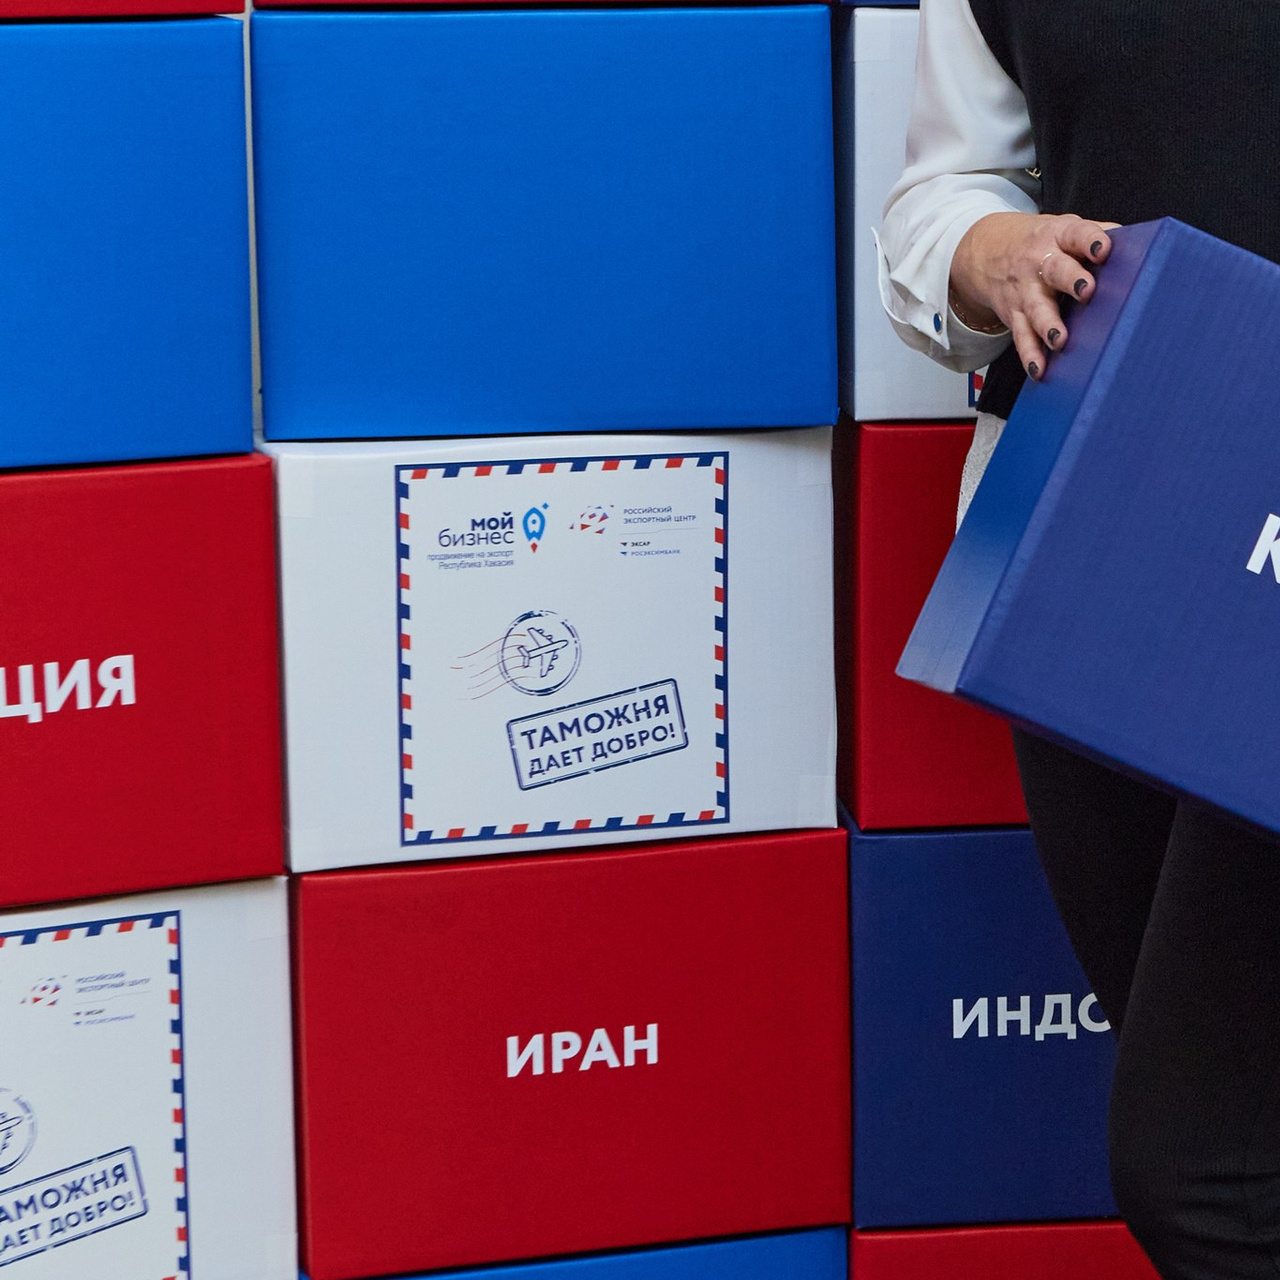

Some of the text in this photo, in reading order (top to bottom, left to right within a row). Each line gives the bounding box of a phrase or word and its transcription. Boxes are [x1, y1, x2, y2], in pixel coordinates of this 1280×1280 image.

[471, 511, 514, 531] мой
[623, 505, 673, 515] РОССИЙСКИЙ
[623, 515, 697, 525] ЭКСПОРТНЫЙ ЦЕНТР
[438, 528, 515, 548] бизнес
[520, 694, 671, 750] ТАМОЖНЯ
[528, 722, 676, 779] ДАЕТ ДОБРО!
[506, 1023, 659, 1078] ИРАН
[48, 1190, 136, 1238] ДОБРО!
